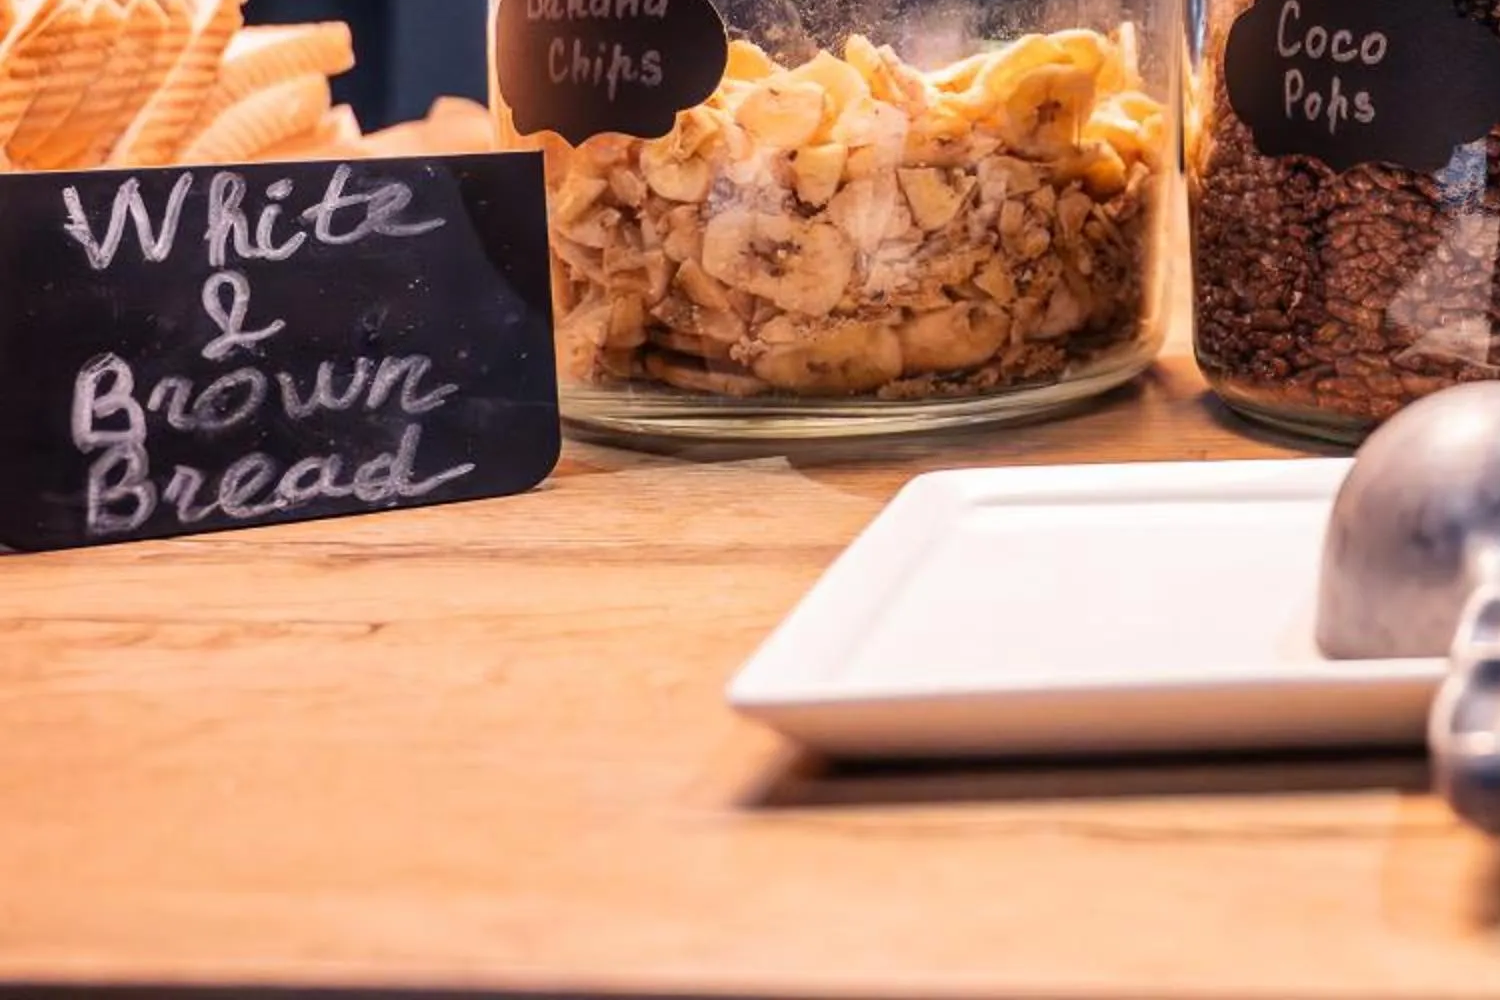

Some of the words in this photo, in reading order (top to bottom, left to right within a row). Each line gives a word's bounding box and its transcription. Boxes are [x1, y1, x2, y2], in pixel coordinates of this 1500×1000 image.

[549, 37, 663, 102] Chips
[1277, 0, 1388, 65] Coco
[1284, 68, 1376, 135] Pops
[62, 164, 446, 271] White
[202, 269, 286, 361] &
[71, 352, 459, 454] Brown
[87, 422, 476, 537] Bread
